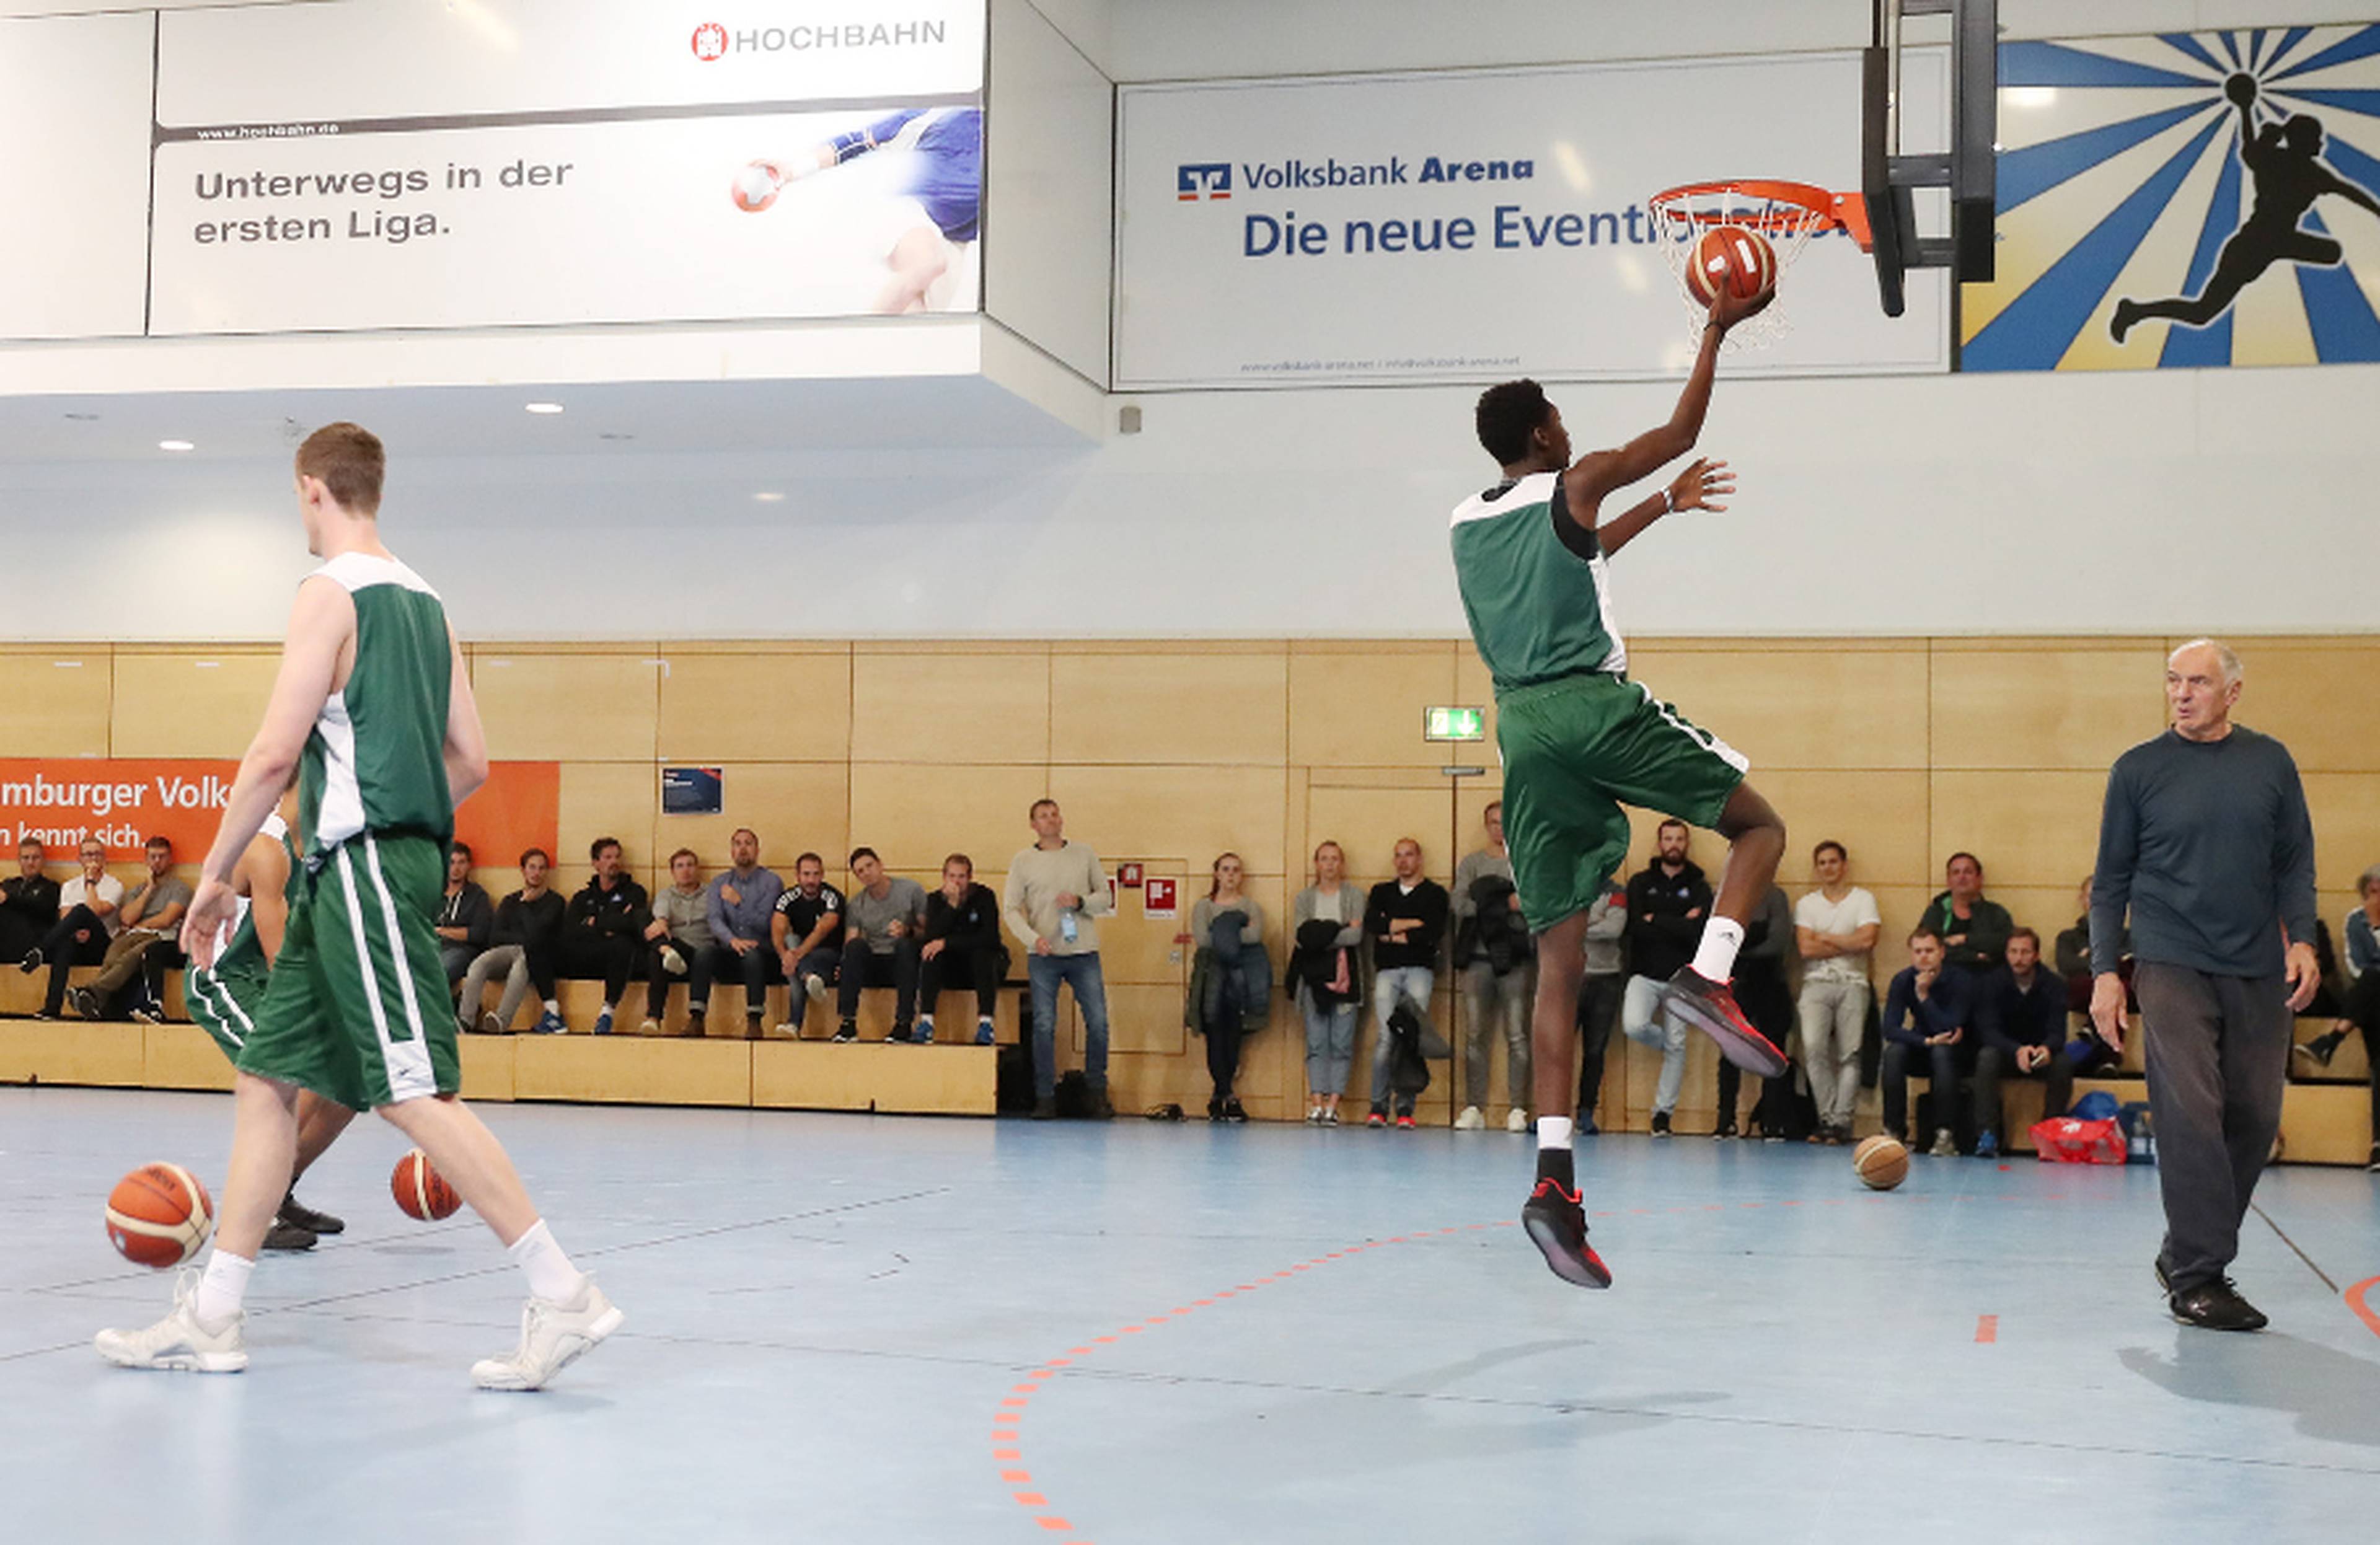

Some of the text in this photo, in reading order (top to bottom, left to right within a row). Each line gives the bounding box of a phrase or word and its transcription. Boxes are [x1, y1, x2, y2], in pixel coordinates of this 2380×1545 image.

[736, 19, 946, 53] HOCHBAHN
[195, 159, 573, 200] Unterwegs in der
[1243, 156, 1534, 190] Volksbank Arena
[194, 210, 451, 244] ersten Liga.
[1243, 211, 1329, 257] Die
[1344, 218, 1477, 254] neue
[2, 773, 236, 816] mburger Volk
[18, 821, 89, 847] kennt
[94, 823, 146, 848] sich.
